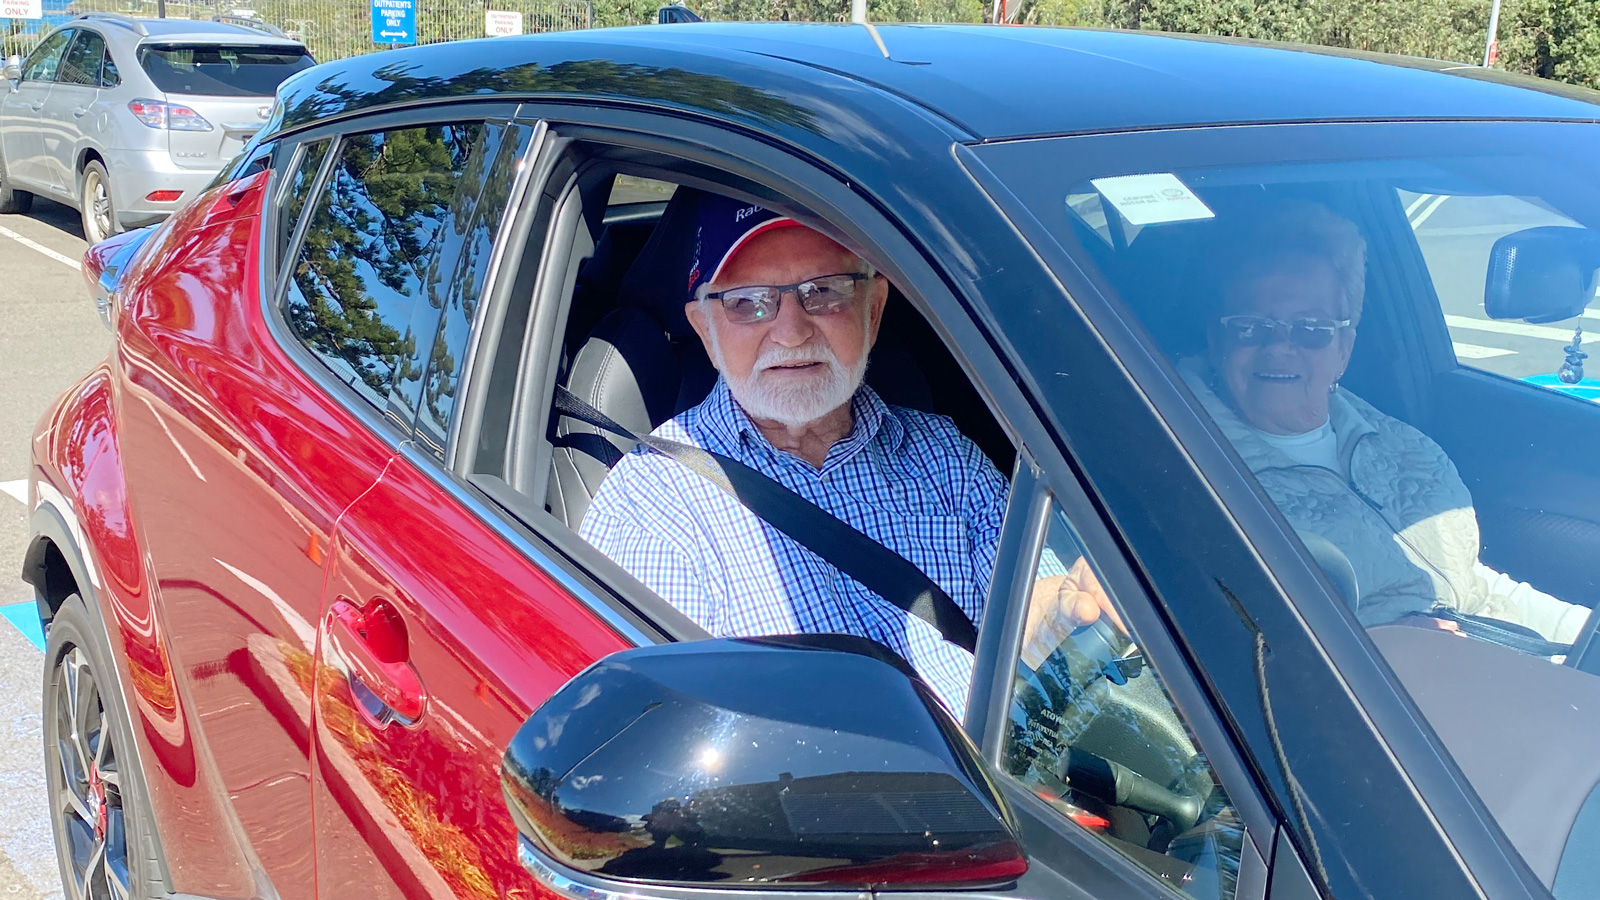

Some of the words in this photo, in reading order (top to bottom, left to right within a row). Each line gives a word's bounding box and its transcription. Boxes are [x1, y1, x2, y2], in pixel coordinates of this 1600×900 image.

[374, 0, 412, 9] OUTPATIENTS
[4, 7, 29, 15] ONLY
[381, 9, 405, 18] PARKING
[386, 17, 401, 26] ONLY
[496, 26, 513, 34] ONLY
